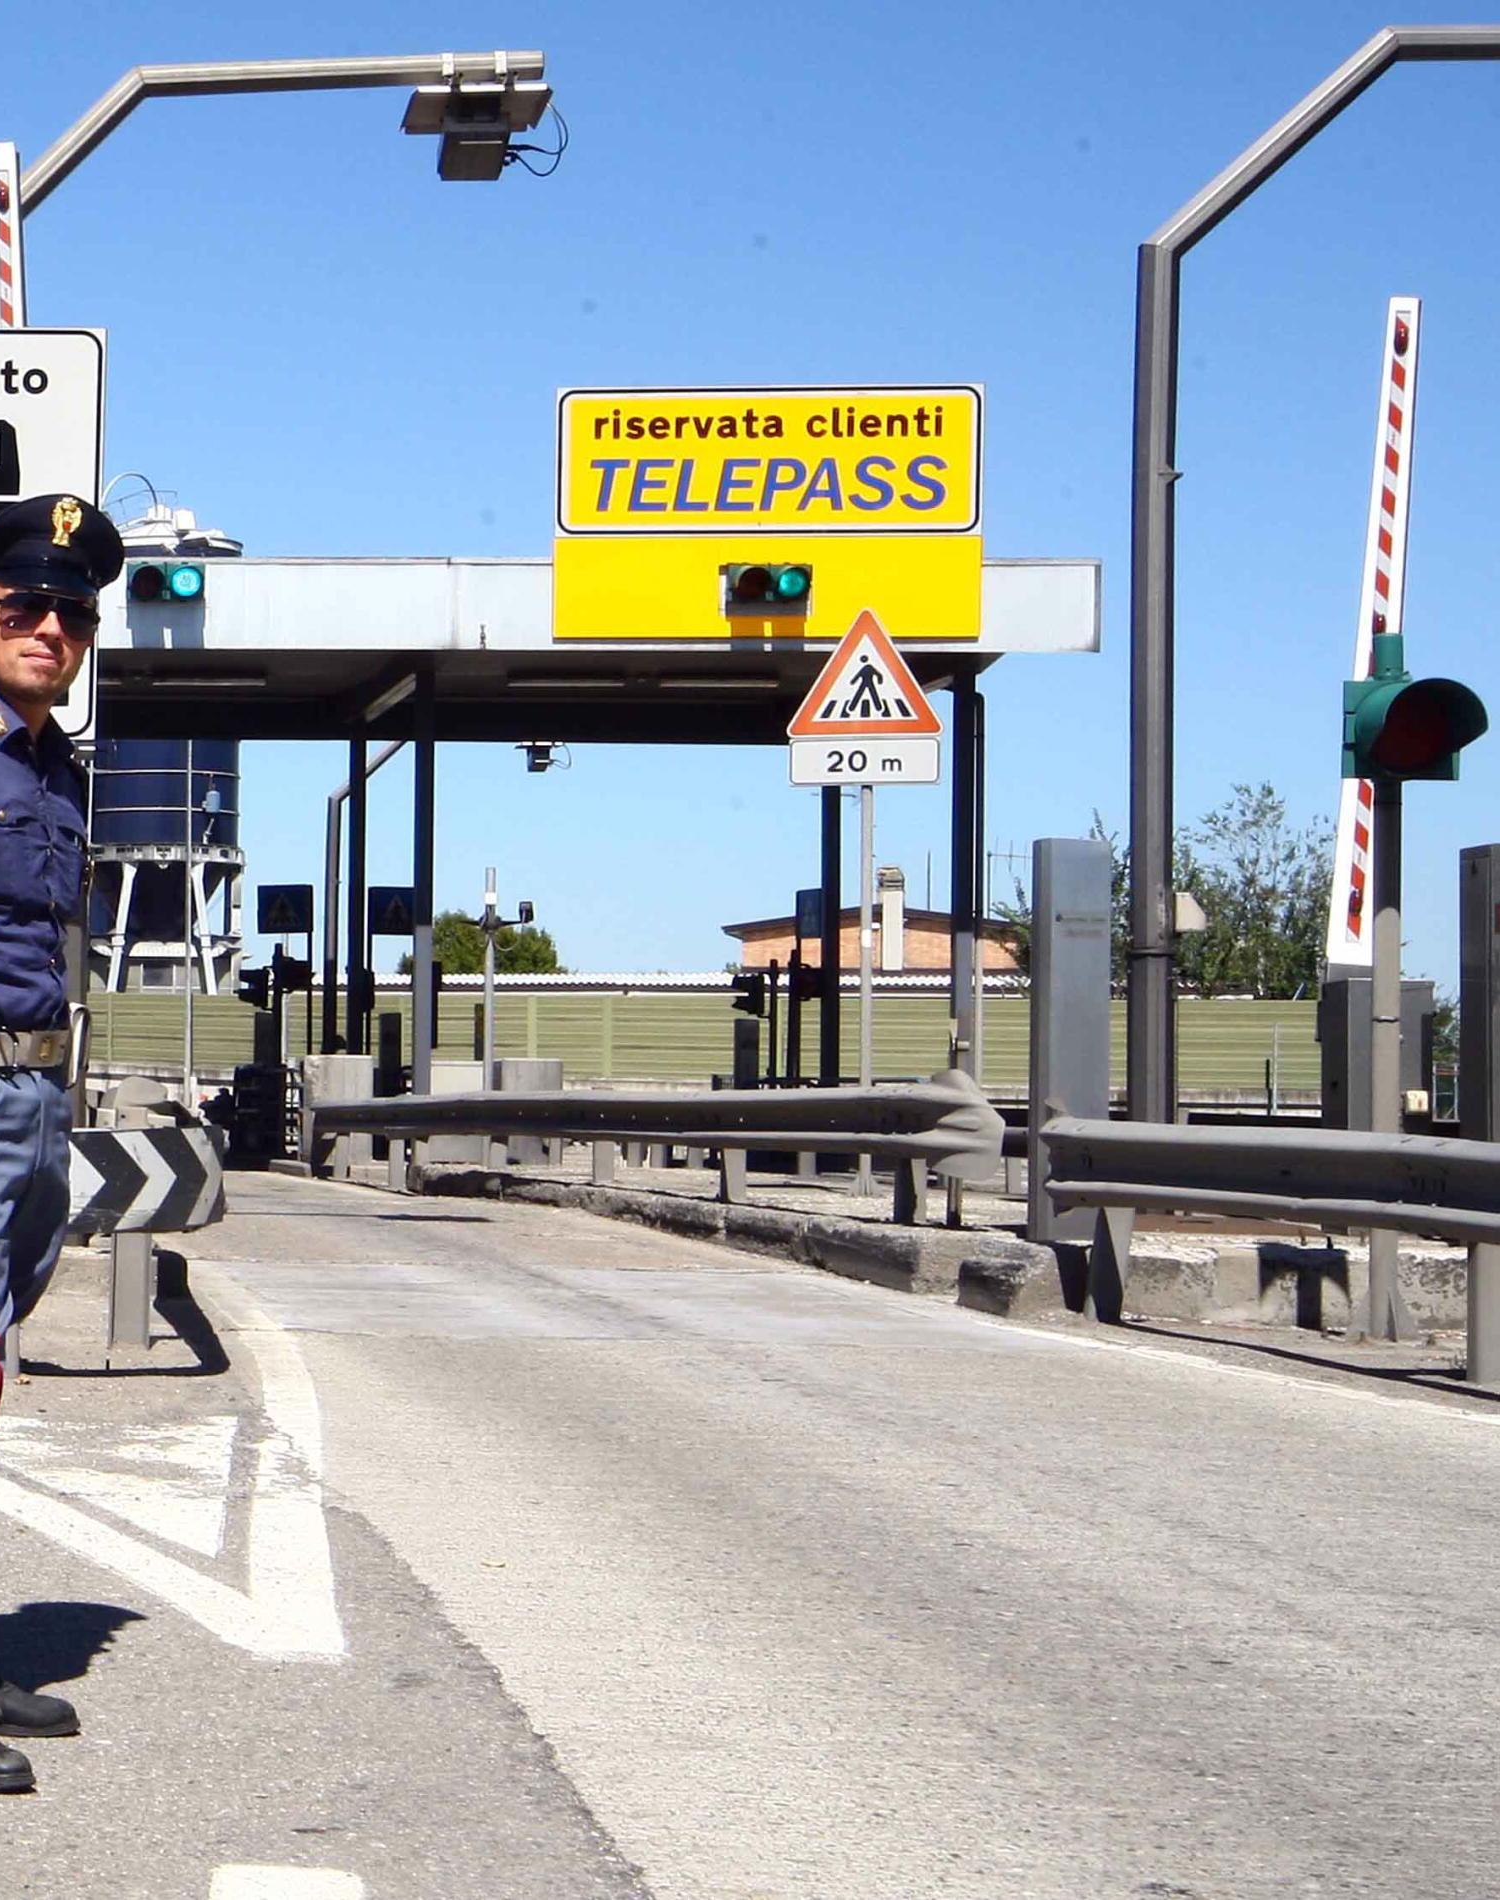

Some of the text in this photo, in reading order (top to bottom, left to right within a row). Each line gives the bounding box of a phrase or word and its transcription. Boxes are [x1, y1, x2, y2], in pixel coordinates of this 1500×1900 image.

[593, 405, 944, 440] riservata clienti
[590, 455, 948, 512] TELEPASS
[826, 750, 903, 773] 20 m
